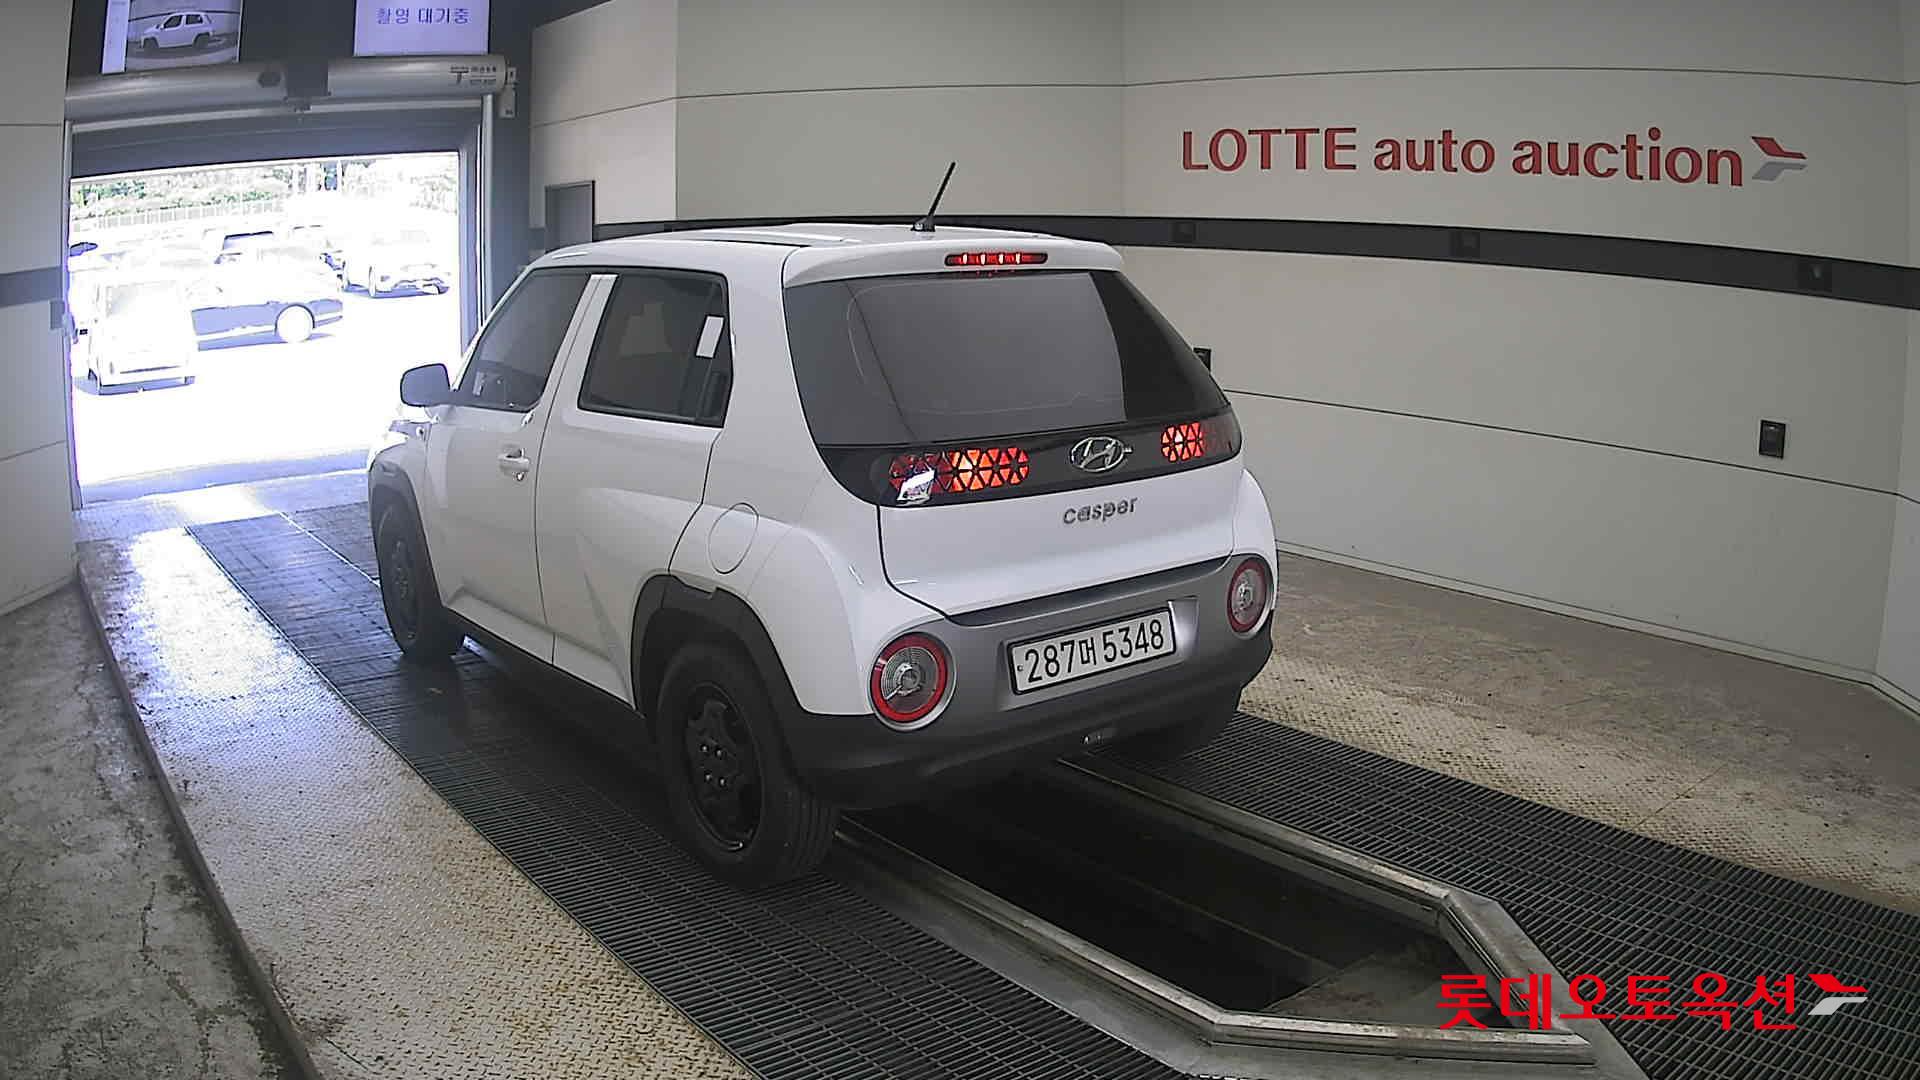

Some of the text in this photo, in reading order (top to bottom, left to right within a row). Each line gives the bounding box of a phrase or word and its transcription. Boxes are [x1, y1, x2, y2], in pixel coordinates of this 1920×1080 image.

[418, 8, 469, 24] 대기중
[1182, 127, 1743, 186] LOTTE auto auction
[1063, 497, 1138, 524] casper
